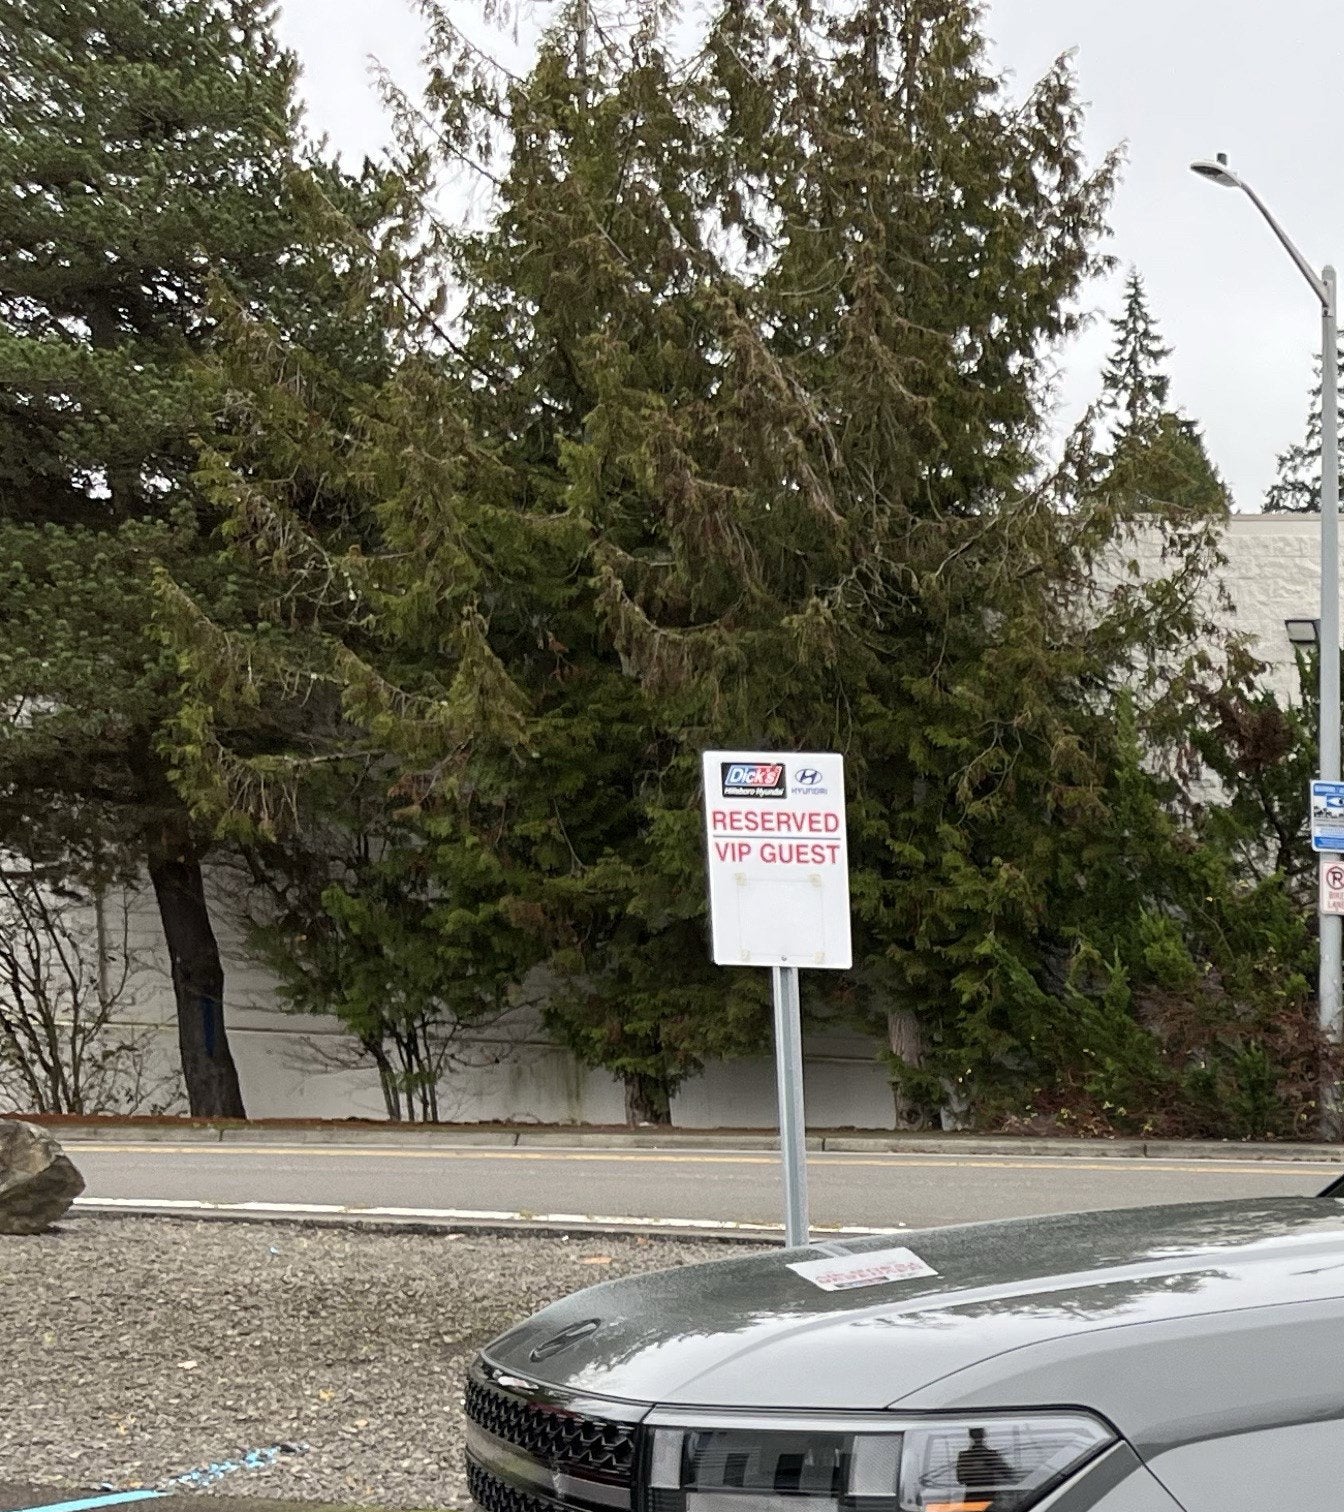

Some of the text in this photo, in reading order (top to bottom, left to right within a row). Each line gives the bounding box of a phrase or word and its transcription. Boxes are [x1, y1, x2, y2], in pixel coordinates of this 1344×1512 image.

[731, 766, 777, 784] Dick's
[712, 811, 840, 833] RESERVED
[715, 843, 840, 865] VIP GUEST
